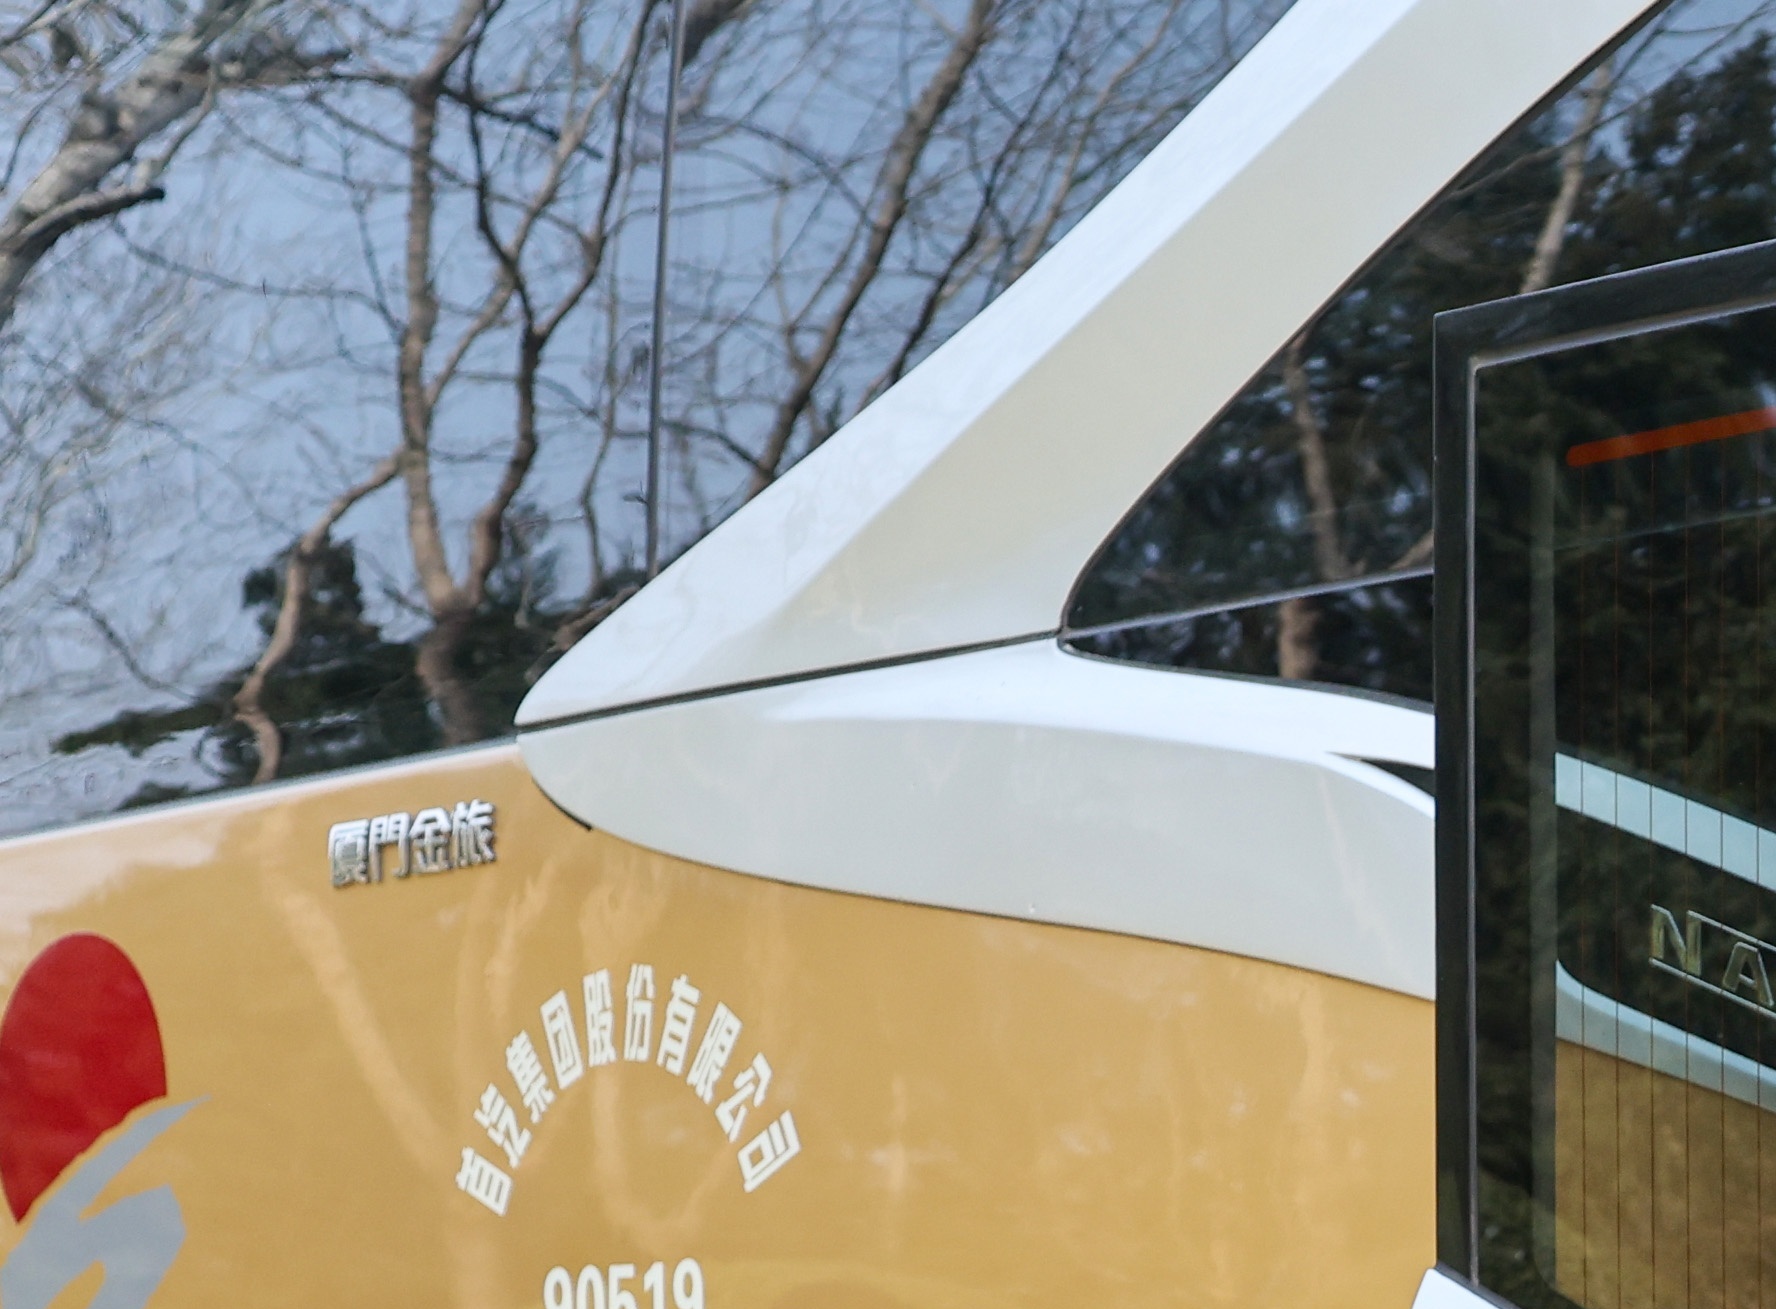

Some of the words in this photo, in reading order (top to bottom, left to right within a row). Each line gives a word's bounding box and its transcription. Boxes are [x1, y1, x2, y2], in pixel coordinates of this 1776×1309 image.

[455, 964, 801, 1216] 首汽集团股份有限公司
